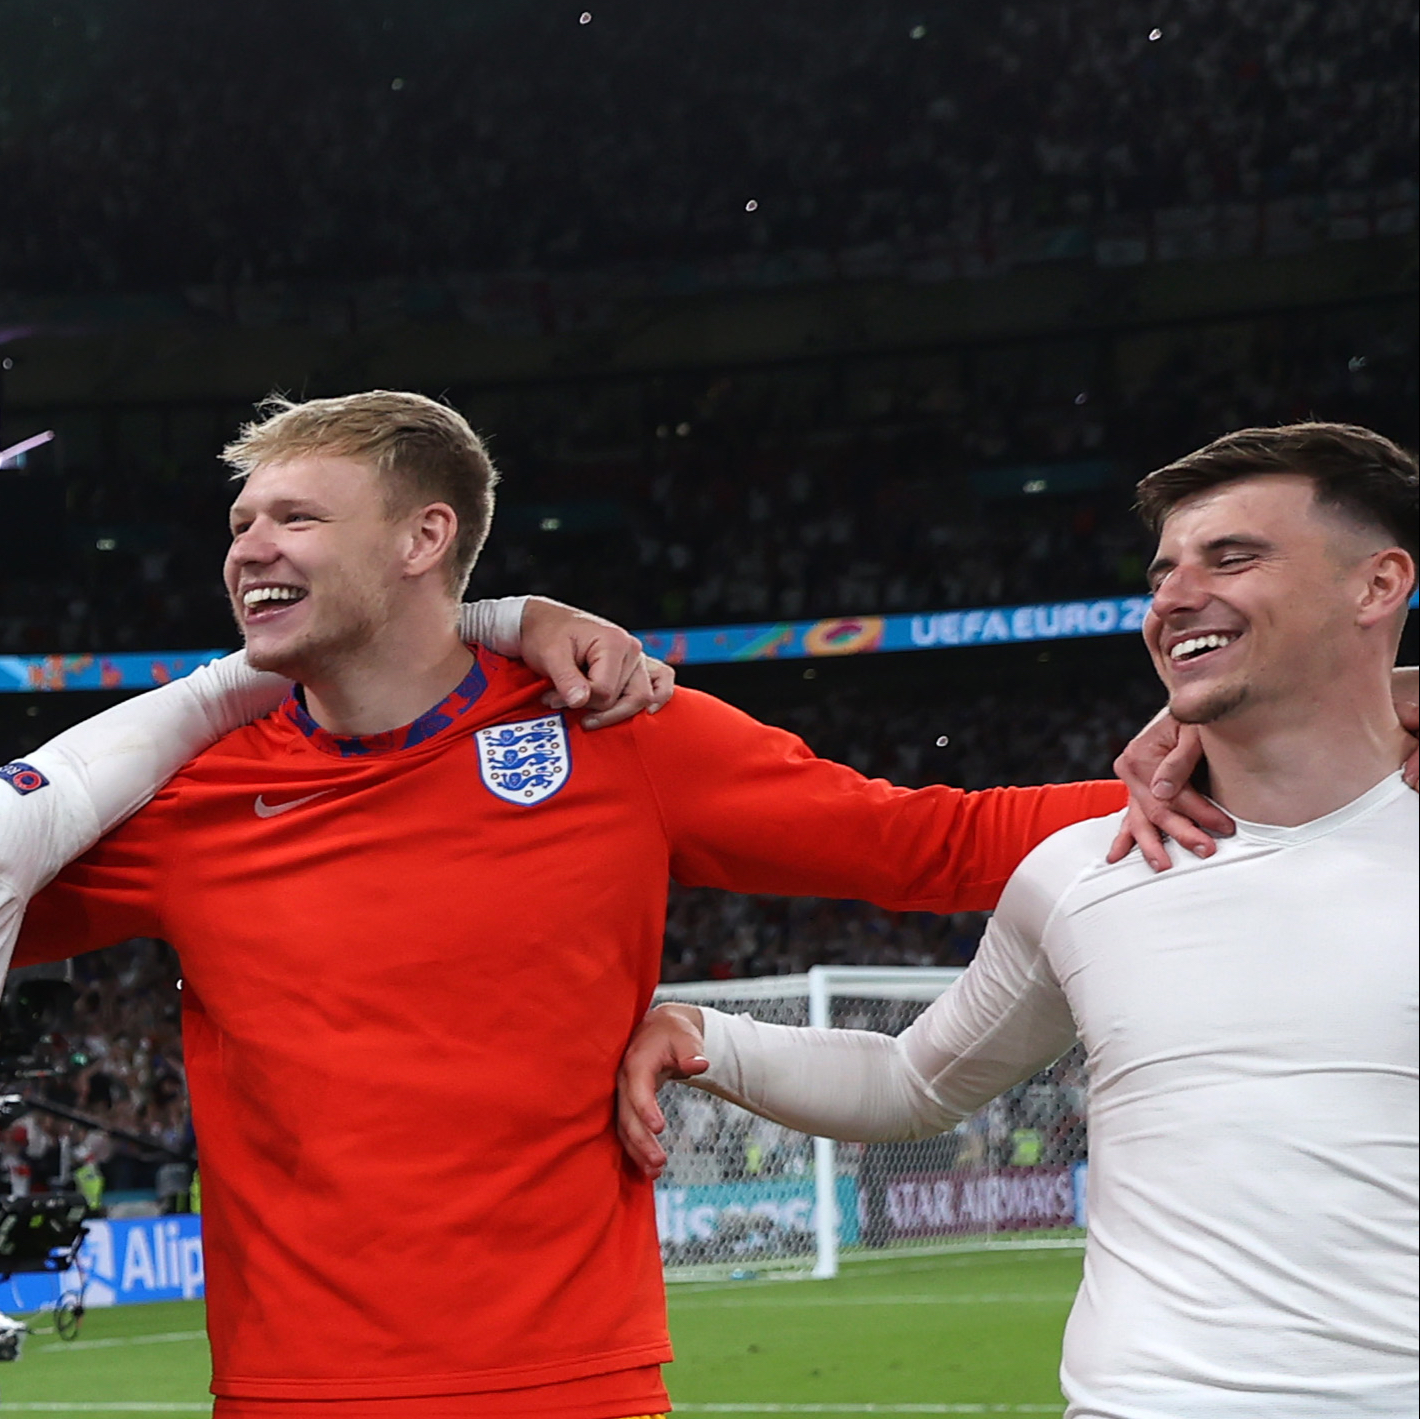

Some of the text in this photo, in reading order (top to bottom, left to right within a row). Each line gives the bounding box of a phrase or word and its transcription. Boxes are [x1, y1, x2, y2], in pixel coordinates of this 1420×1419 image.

[911, 611, 1011, 647] UEFA
[1012, 601, 1119, 640] EURO
[121, 1222, 204, 1299] Alip
